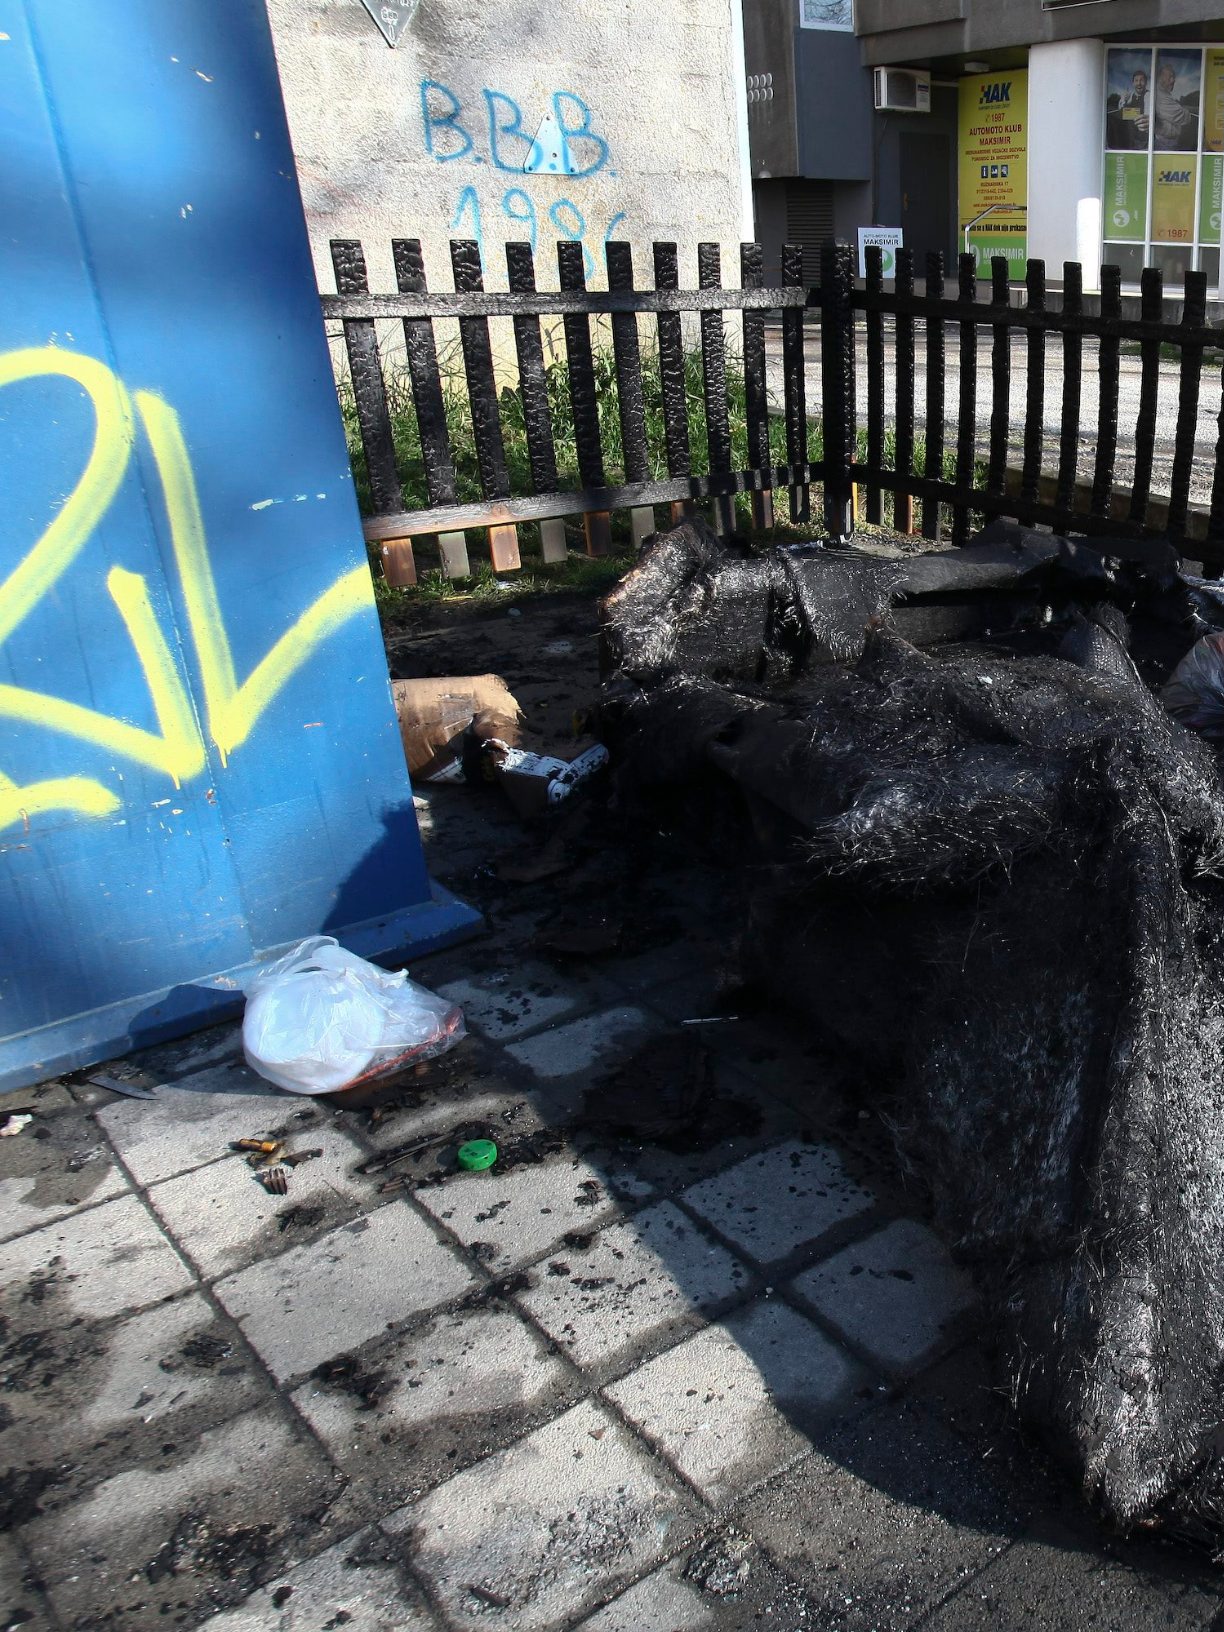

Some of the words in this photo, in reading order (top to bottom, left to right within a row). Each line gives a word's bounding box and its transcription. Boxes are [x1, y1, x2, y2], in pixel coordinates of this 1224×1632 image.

[979, 82, 1012, 104] HAK
[991, 113, 1005, 122] 1987
[969, 126, 1003, 136] AUTOMOTO
[1004, 124, 1022, 133] KLUB
[979, 136, 1011, 146] MAKSIMIR
[1116, 156, 1124, 206] MAKSIMIR
[1158, 171, 1192, 183] HAK
[1213, 158, 1222, 209] MAKSIMIR
[1167, 230, 1188, 238] 1987
[982, 248, 1024, 260] MAKSIMIR
